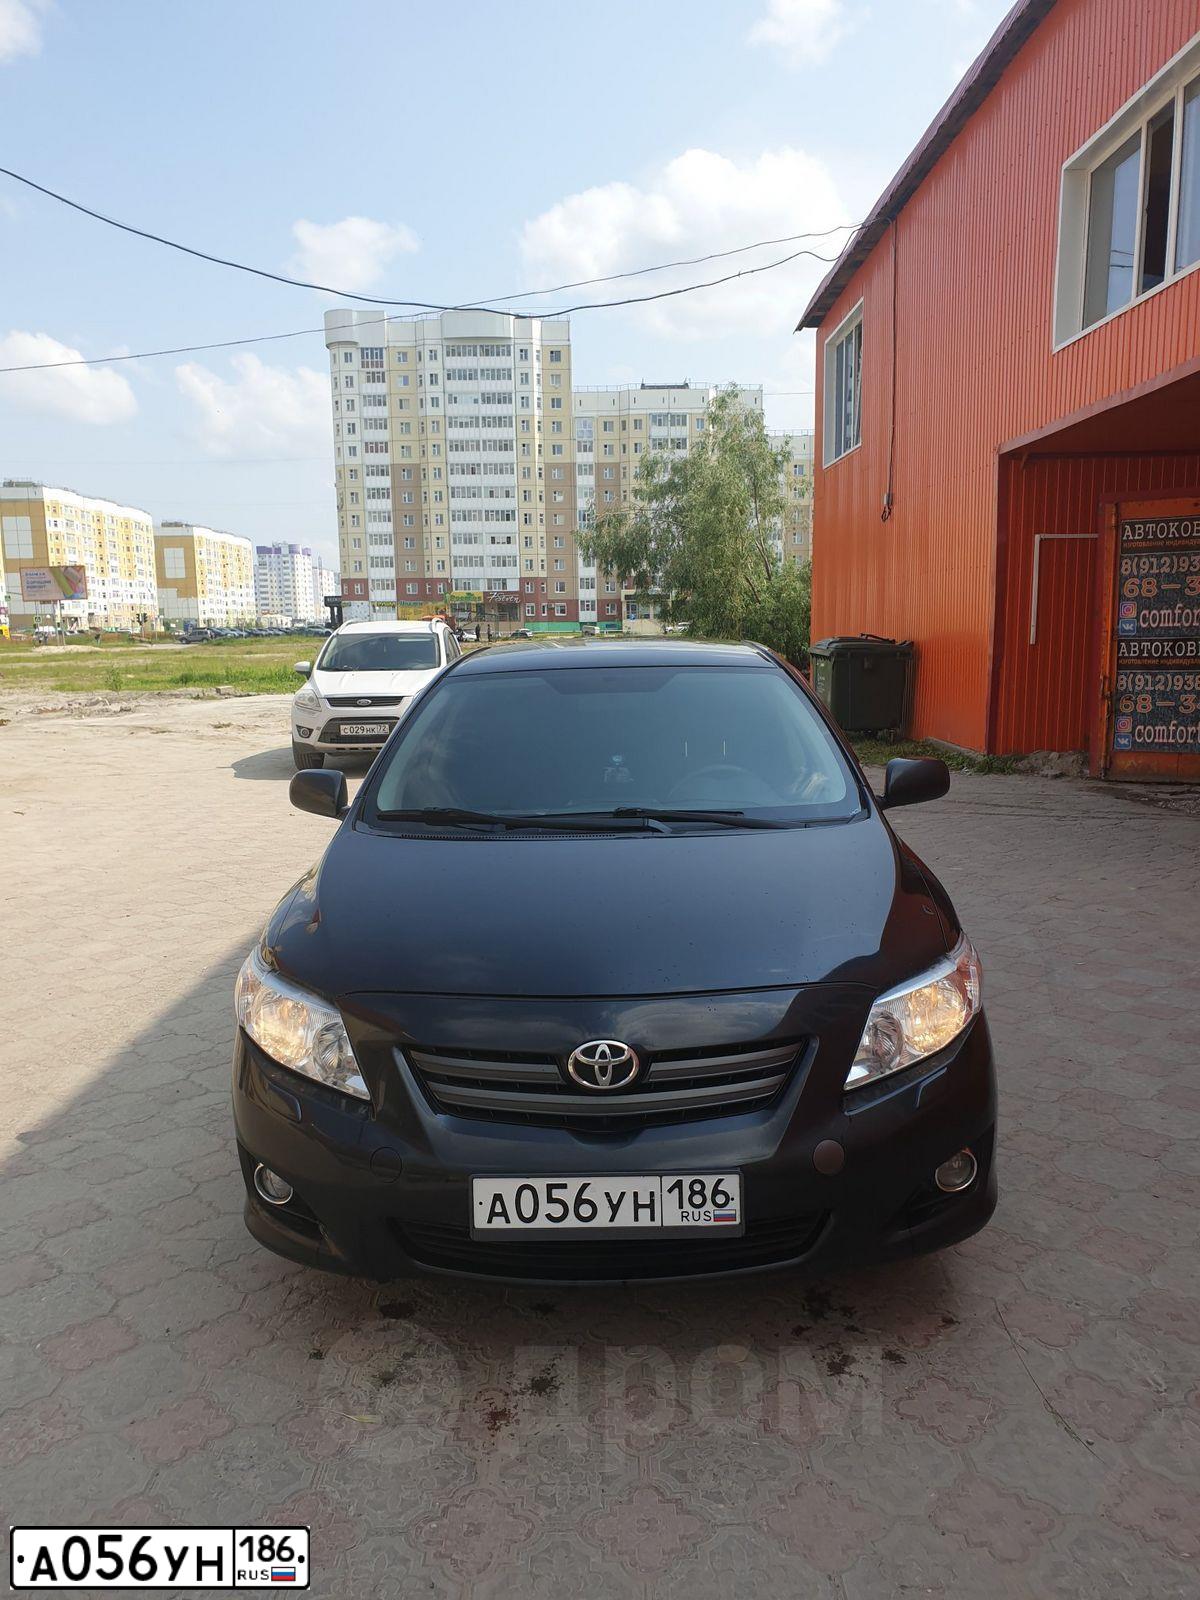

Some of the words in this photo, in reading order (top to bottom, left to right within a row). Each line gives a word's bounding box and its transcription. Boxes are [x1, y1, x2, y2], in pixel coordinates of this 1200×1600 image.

[1118, 641, 1200, 657] АВТОКОВ
[486, 1182, 656, 1225] А056УН
[666, 1178, 732, 1210] 186
[680, 1211, 712, 1222] RUS
